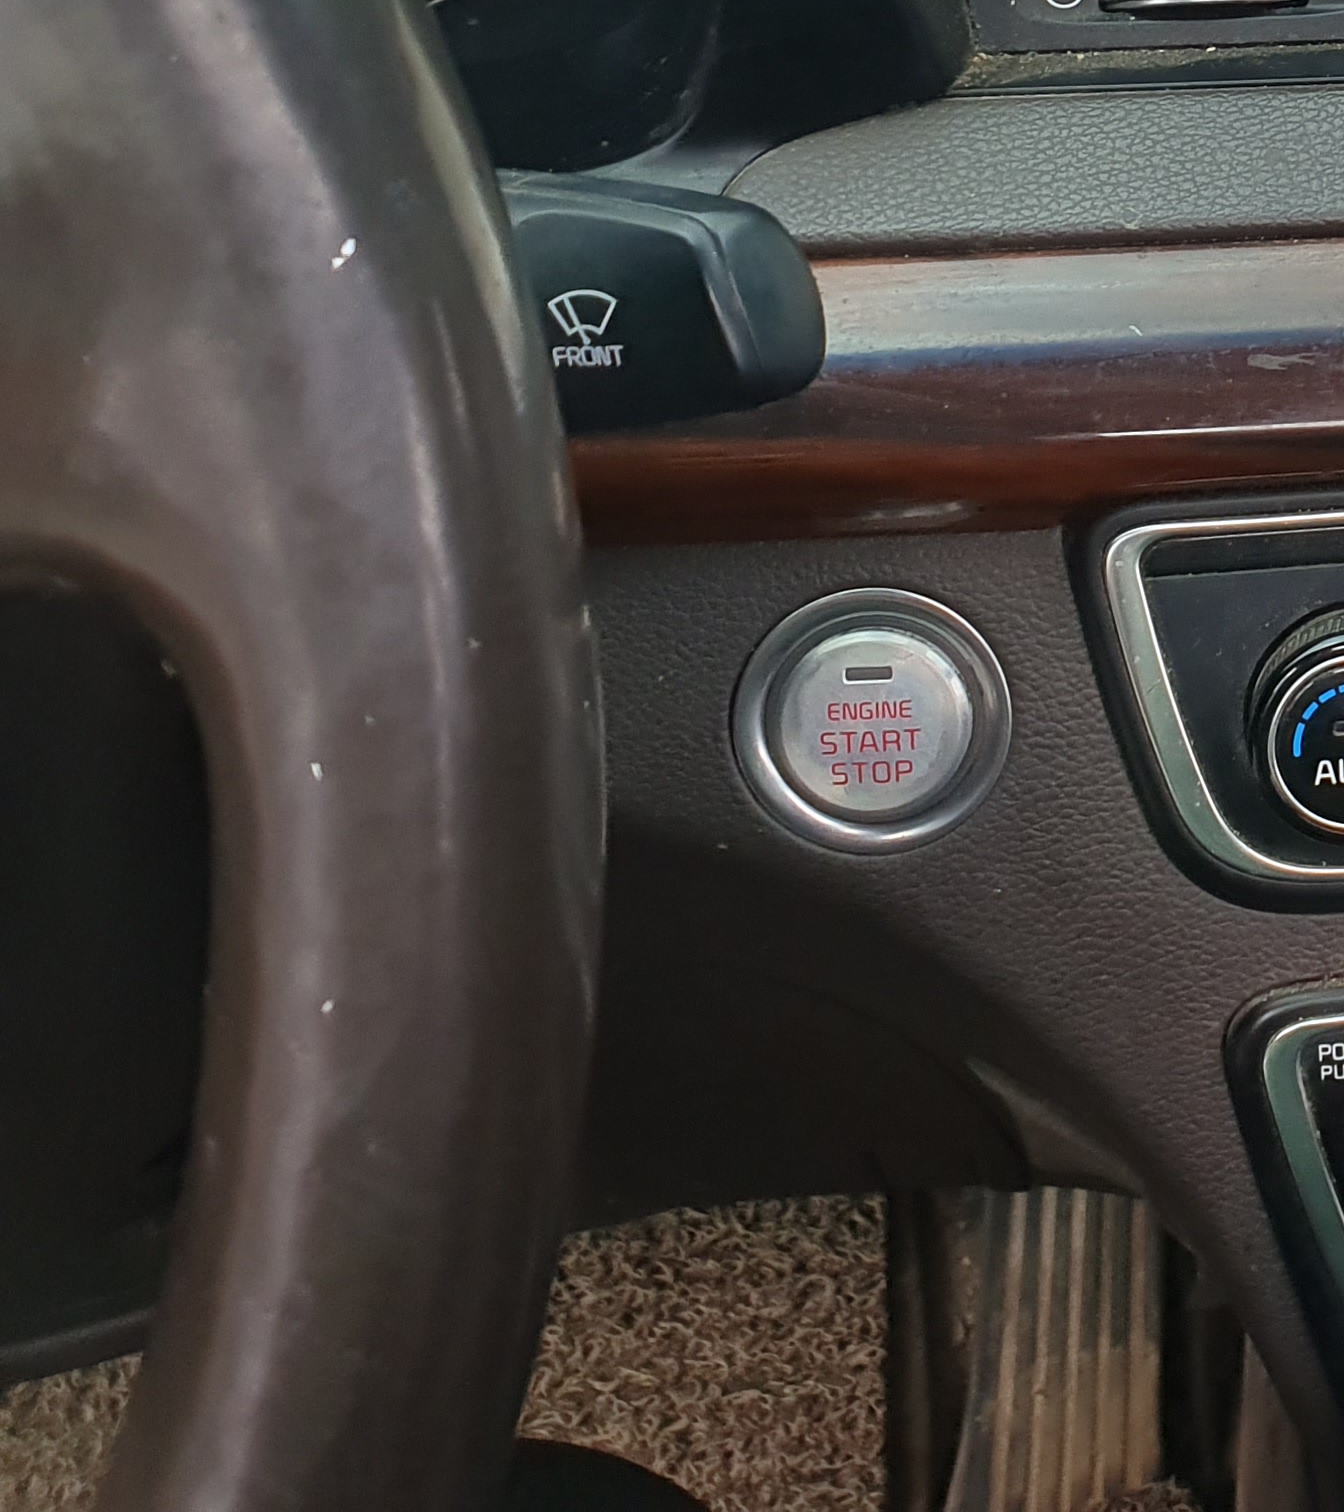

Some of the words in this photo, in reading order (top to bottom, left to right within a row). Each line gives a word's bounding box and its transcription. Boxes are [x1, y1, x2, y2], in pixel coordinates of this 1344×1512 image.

[552, 345, 624, 367] FRONT
[827, 700, 914, 722] ENGINE
[820, 728, 922, 756] START
[831, 760, 914, 786] STOP
